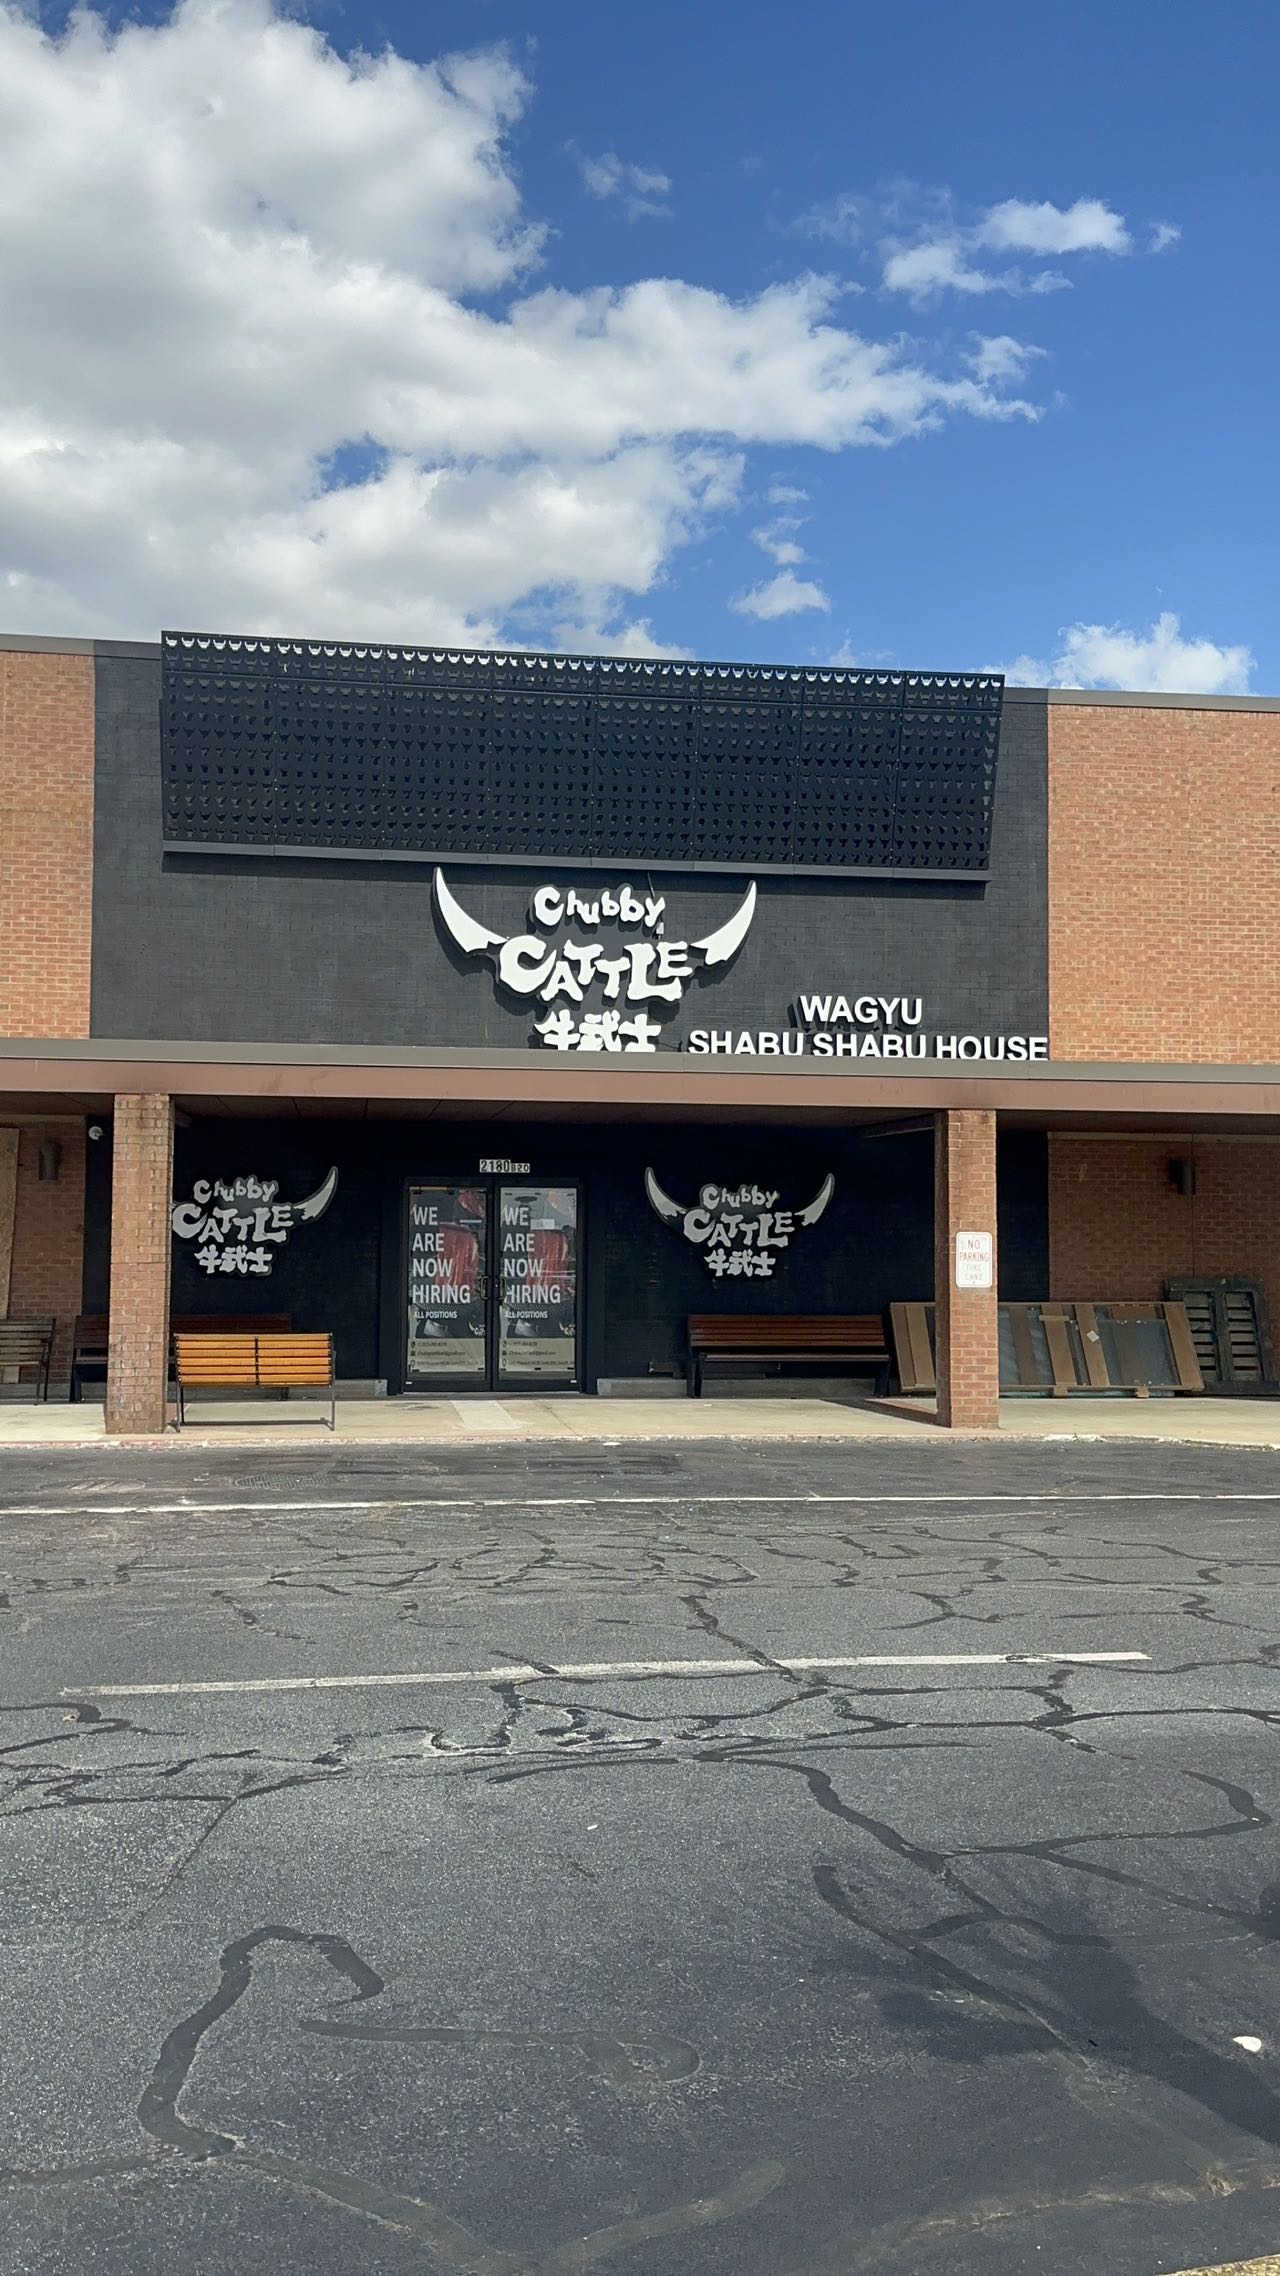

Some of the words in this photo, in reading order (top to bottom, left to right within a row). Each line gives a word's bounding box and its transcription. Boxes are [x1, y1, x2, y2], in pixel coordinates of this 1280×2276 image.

[534, 886, 665, 927] Chubby
[500, 935, 692, 1001] CATTLE
[800, 995, 922, 1025] WAGYU
[534, 1009, 662, 1052] 牛武士
[688, 1030, 803, 1056] SHABU
[812, 1033, 926, 1059] SHABU
[936, 1036, 1048, 1061] HOUSE
[194, 1178, 276, 1204] Chubby
[703, 1185, 779, 1209] Chubby
[172, 1203, 294, 1243] CATTLE
[412, 1206, 438, 1225] WE
[503, 1206, 529, 1226] WE
[684, 1209, 795, 1247] CATTLE
[412, 1233, 445, 1252] ARE
[503, 1233, 535, 1252] ARE
[967, 1239, 981, 1249] NO
[194, 1244, 273, 1274] 牛武士
[704, 1249, 776, 1276] 牛武士
[959, 1251, 989, 1262] PARKING
[413, 1258, 453, 1277] NOW
[503, 1258, 543, 1277] NOW
[412, 1284, 471, 1304] HIRING
[503, 1284, 561, 1304] HIRING
[413, 1311, 425, 1319] ALL
[425, 1311, 458, 1319] POSITIONS
[516, 1311, 548, 1319] POSITIONS
